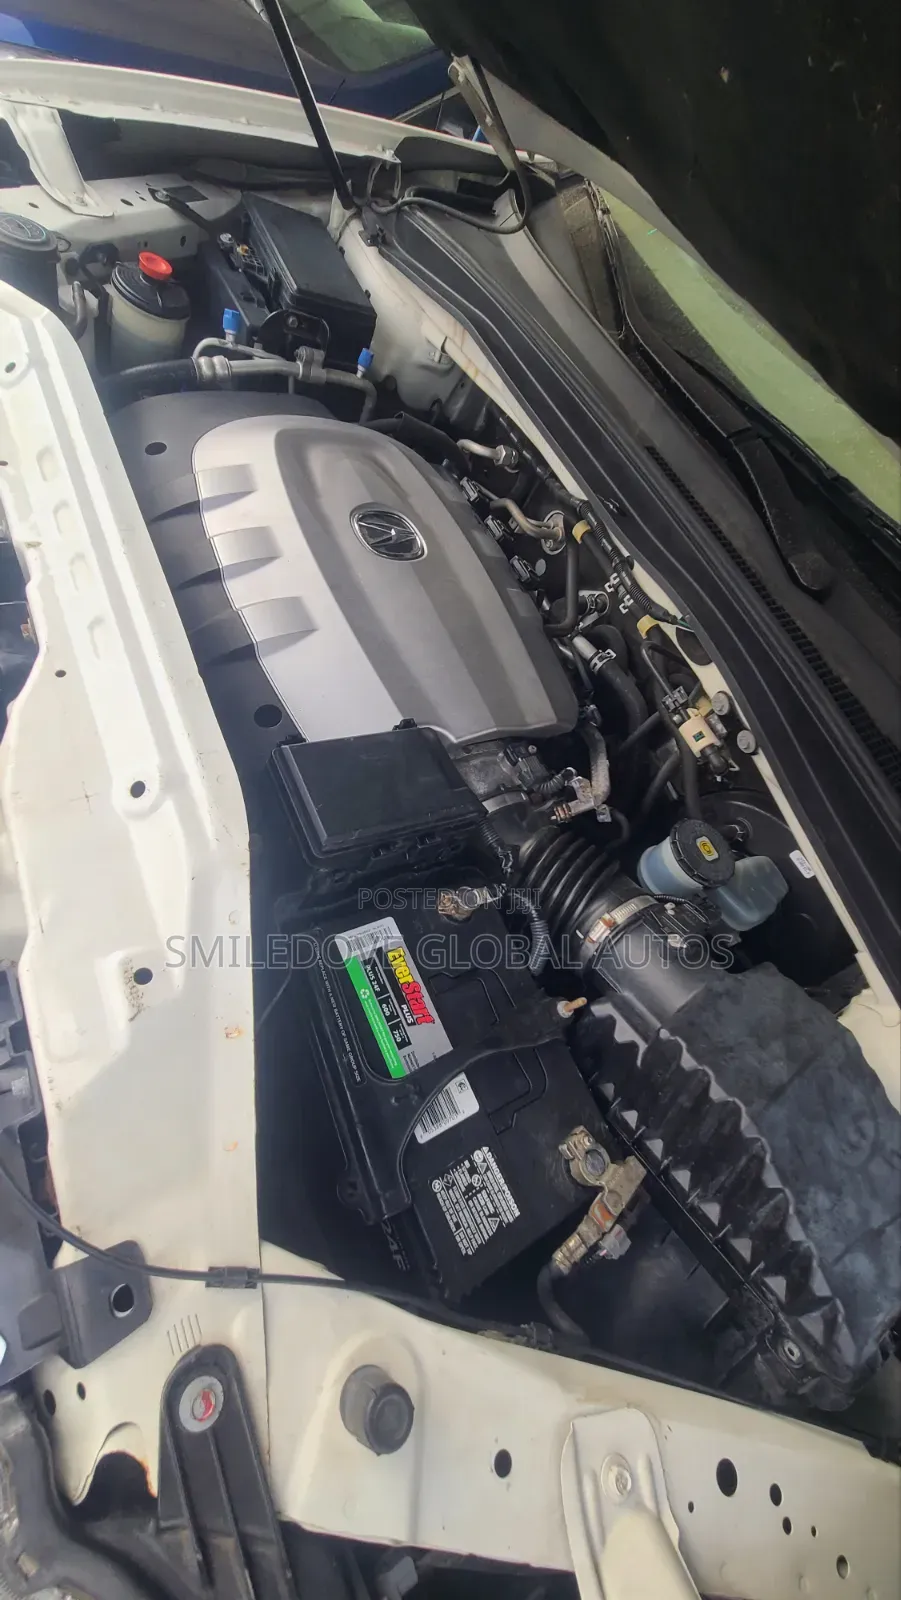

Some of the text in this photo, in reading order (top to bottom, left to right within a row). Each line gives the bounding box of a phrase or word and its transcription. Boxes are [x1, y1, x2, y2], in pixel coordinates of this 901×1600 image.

[366, 964, 381, 993] PLUS 24F
[387, 945, 434, 1025] EverStart
[381, 1003, 391, 1017] 600
[401, 1004, 414, 1024] PLUS
[392, 1029, 402, 1043] 750
